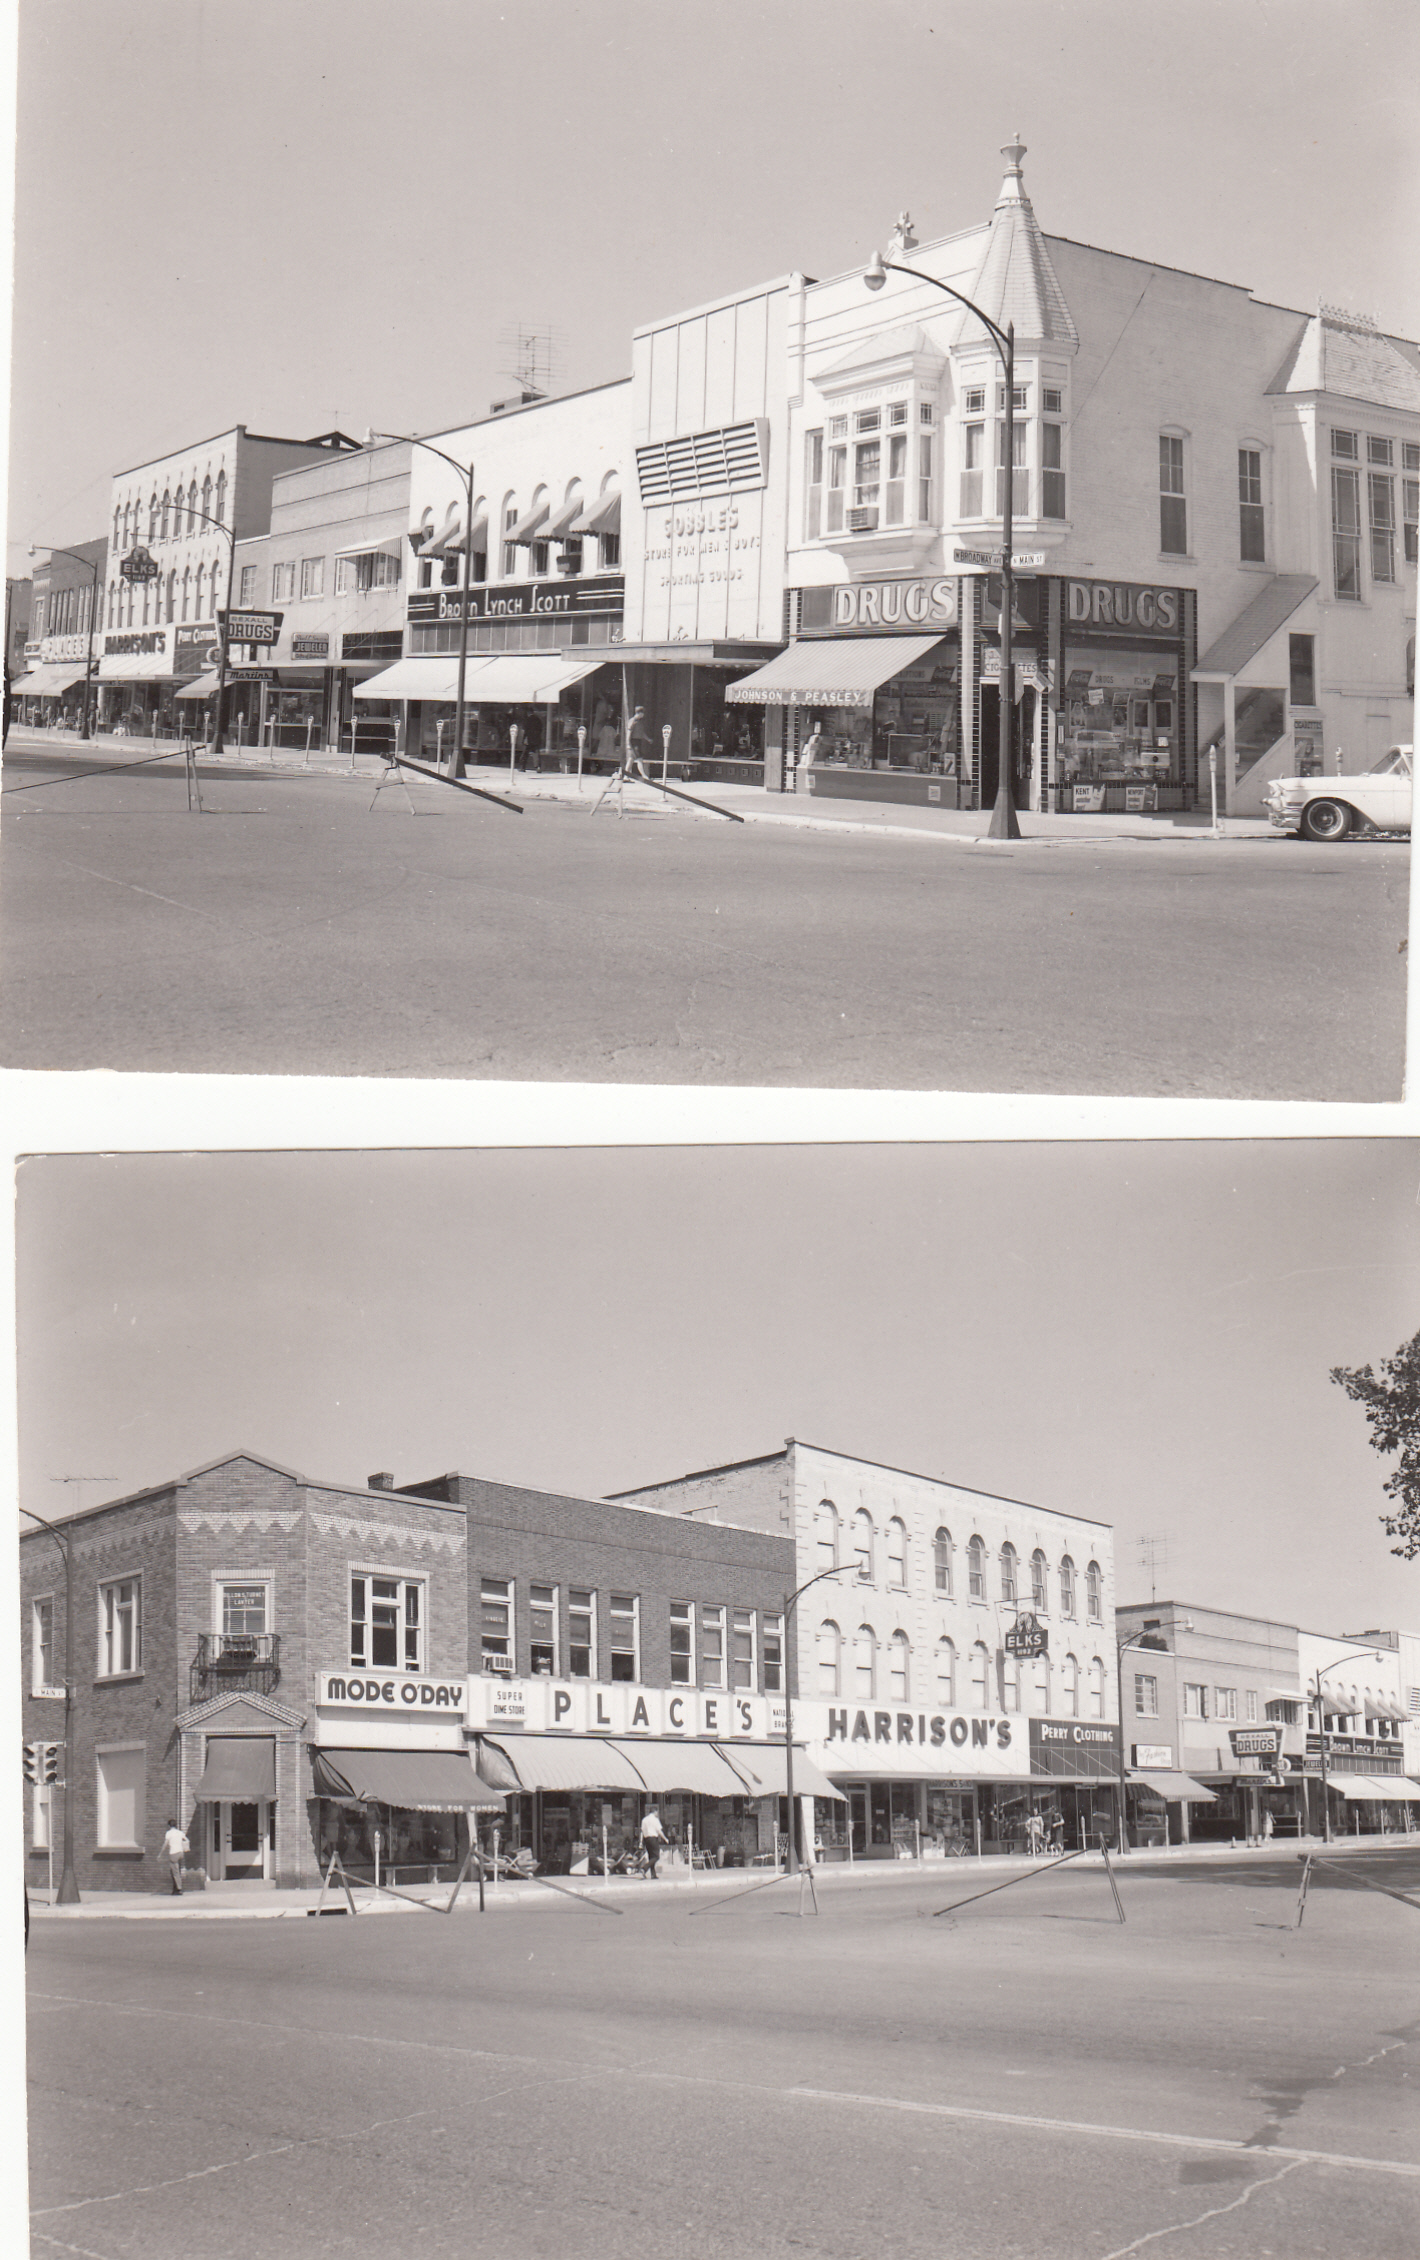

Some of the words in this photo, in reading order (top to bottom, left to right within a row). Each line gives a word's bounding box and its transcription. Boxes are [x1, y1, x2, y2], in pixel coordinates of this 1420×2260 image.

[960, 551, 992, 564] BROADWAY
[1019, 555, 1034, 563] MAIN
[123, 563, 156, 574] ELKS
[530, 585, 570, 612] SCOTT
[835, 580, 956, 625] DRUGS
[1069, 582, 1176, 628] DRUGS
[228, 623, 272, 639] DRUGS
[104, 631, 166, 656] HARRISON'S
[296, 643, 328, 651] JEWELER
[1095, 675, 1114, 683] DRUGS
[735, 690, 783, 701] JOHNSON
[790, 692, 797, 702] &
[805, 692, 861, 703] PEASLEY
[1008, 1634, 1042, 1648] ELKS
[328, 1678, 395, 1703] MODE
[401, 1683, 463, 1706] O'DAY
[497, 1690, 522, 1700] SUPER
[494, 1704, 508, 1713] DIME
[509, 1705, 525, 1715] STORE
[554, 1690, 753, 1730] PLACE'S
[829, 1708, 1012, 1749] HARRISON'S
[1041, 1723, 1068, 1741] PERRY
[1073, 1726, 1113, 1743] CLOTHING
[1237, 1739, 1274, 1751] DRUGS
